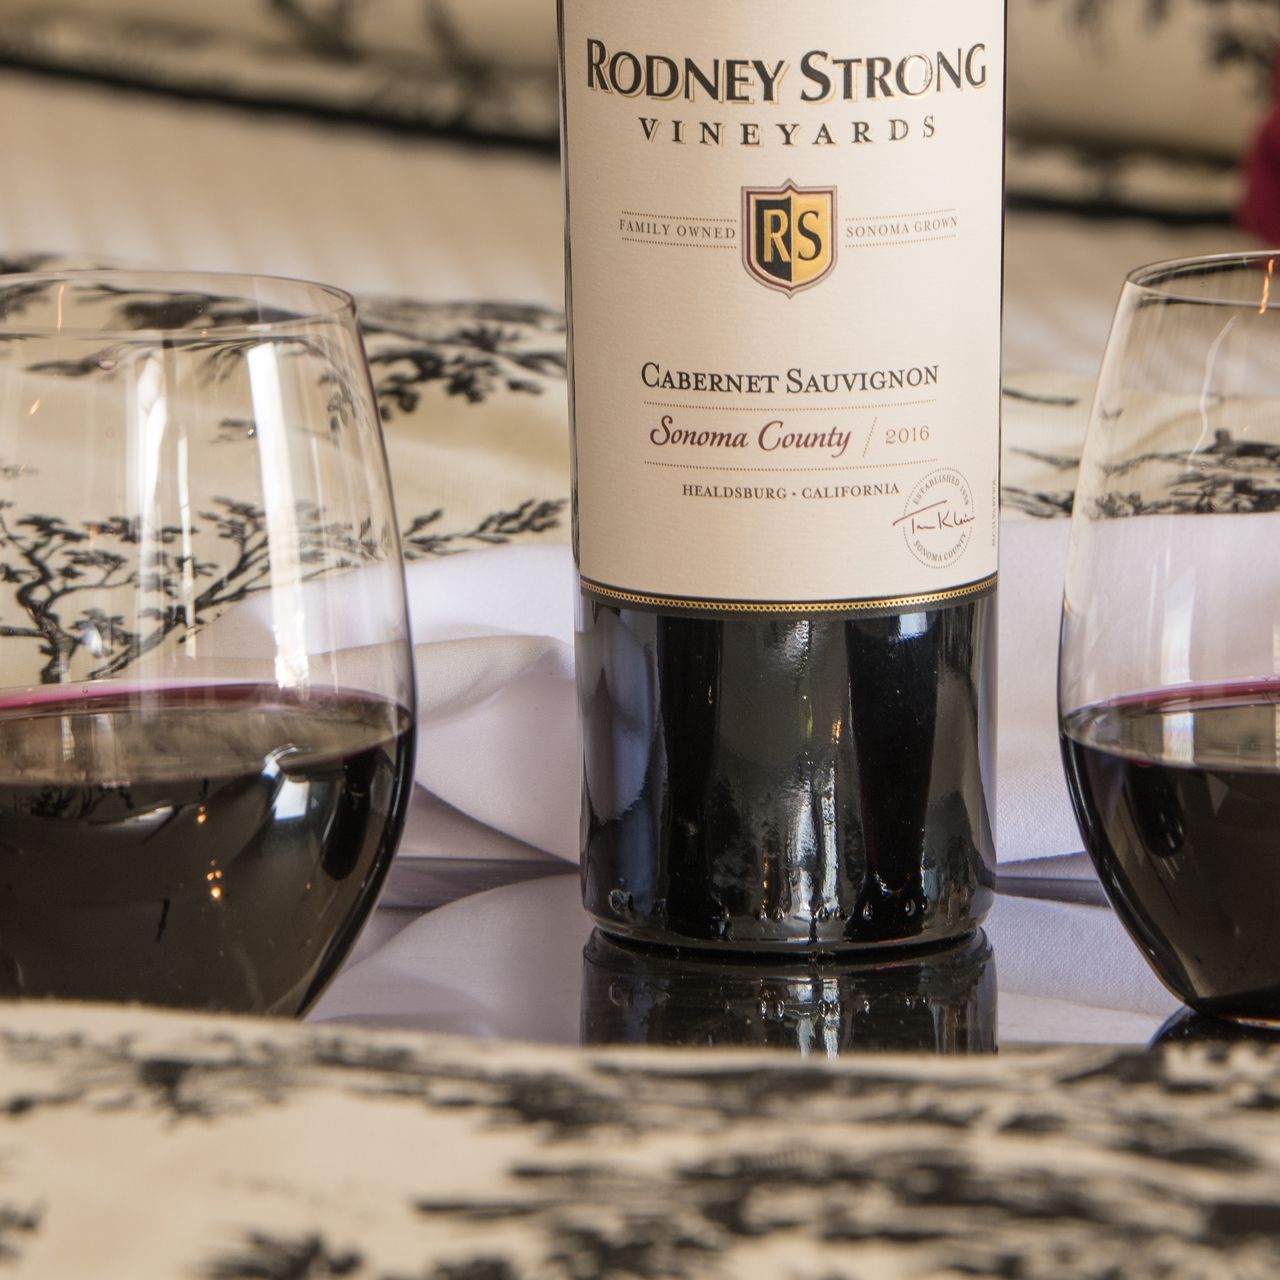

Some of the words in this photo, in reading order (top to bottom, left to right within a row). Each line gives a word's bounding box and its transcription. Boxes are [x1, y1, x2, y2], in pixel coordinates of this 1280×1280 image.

[586, 38, 785, 104] RODNEY
[799, 42, 988, 103] STRONG
[638, 114, 936, 146] VINEYARDS
[619, 218, 670, 236] FAMILY
[676, 224, 736, 239] OWNED
[763, 208, 823, 263] RS
[846, 223, 910, 238] SONOMA
[914, 215, 958, 233] GROWN
[641, 361, 779, 394] CABERNET
[786, 365, 939, 394] SAUVIGNON
[649, 415, 748, 449] Sonoma
[758, 421, 851, 458] County
[885, 424, 930, 445] 2016
[682, 483, 787, 500] HEALDSBURG
[801, 483, 900, 499] CALIFORNIA
[913, 474, 960, 505] ESTABLISHED
[913, 540, 942, 562] SONOMA
[943, 532, 967, 561] COUNTY
